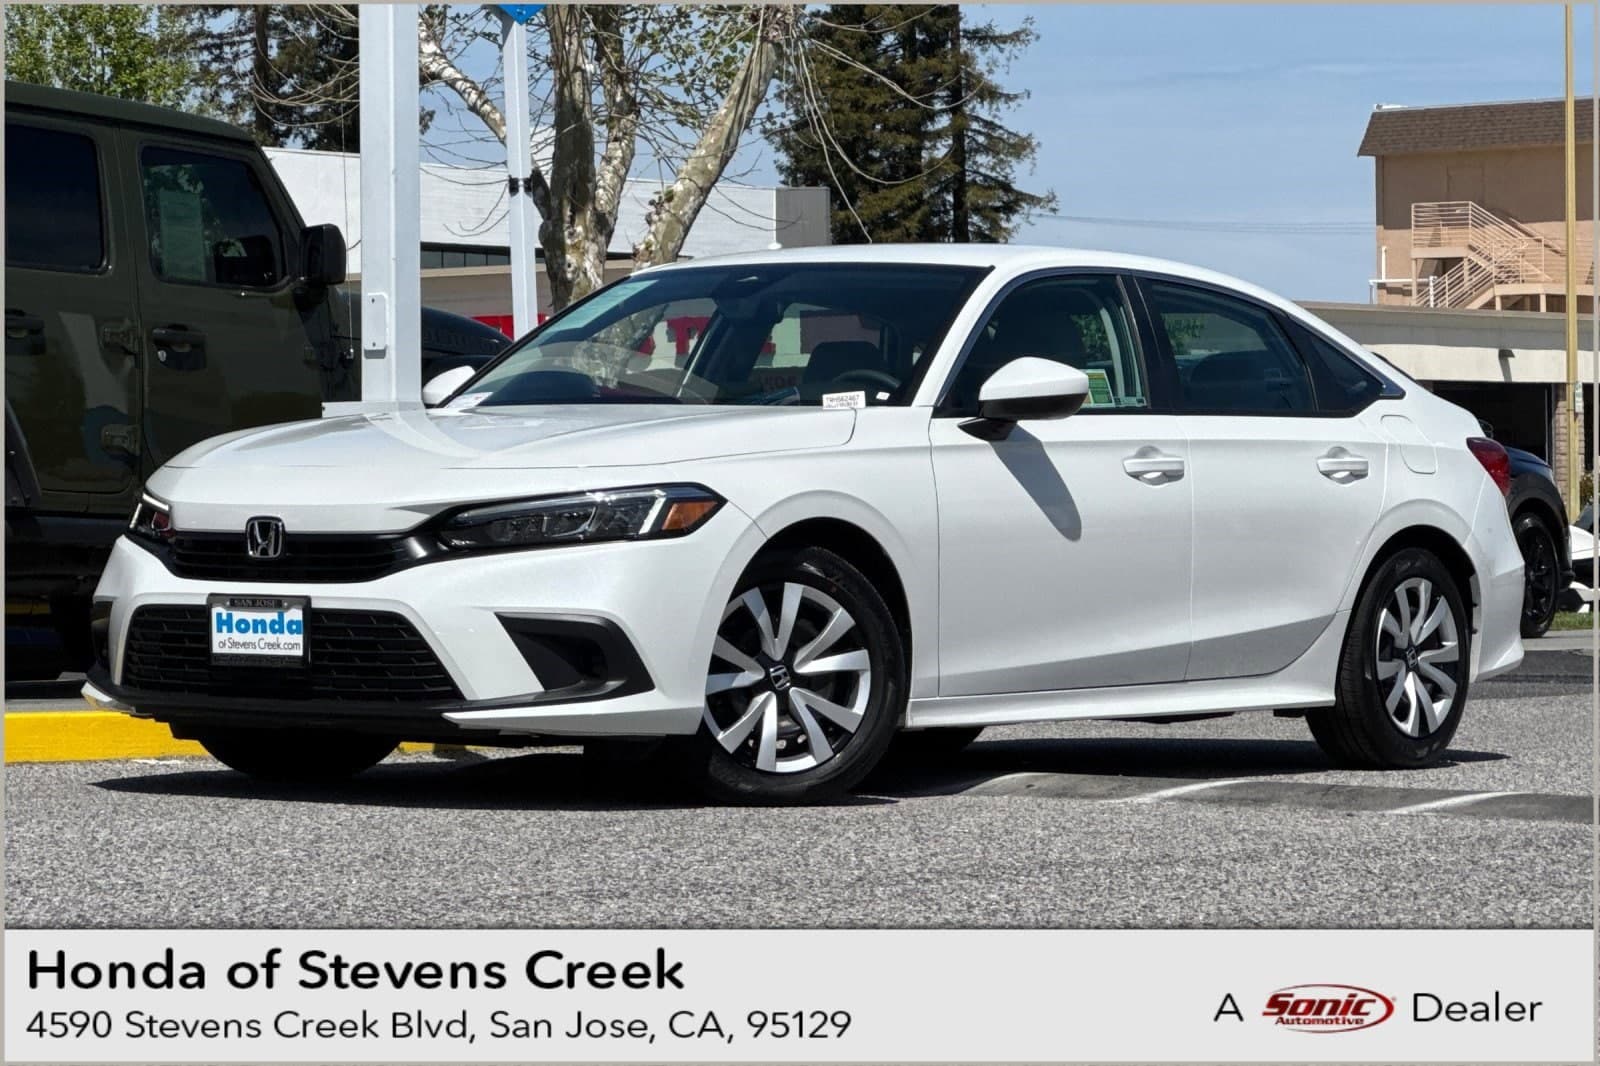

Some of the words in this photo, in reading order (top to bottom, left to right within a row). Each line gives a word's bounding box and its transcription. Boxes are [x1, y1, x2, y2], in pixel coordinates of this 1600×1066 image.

[215, 611, 303, 635] Honda
[218, 638, 227, 649] of
[227, 637, 257, 650] Stevens
